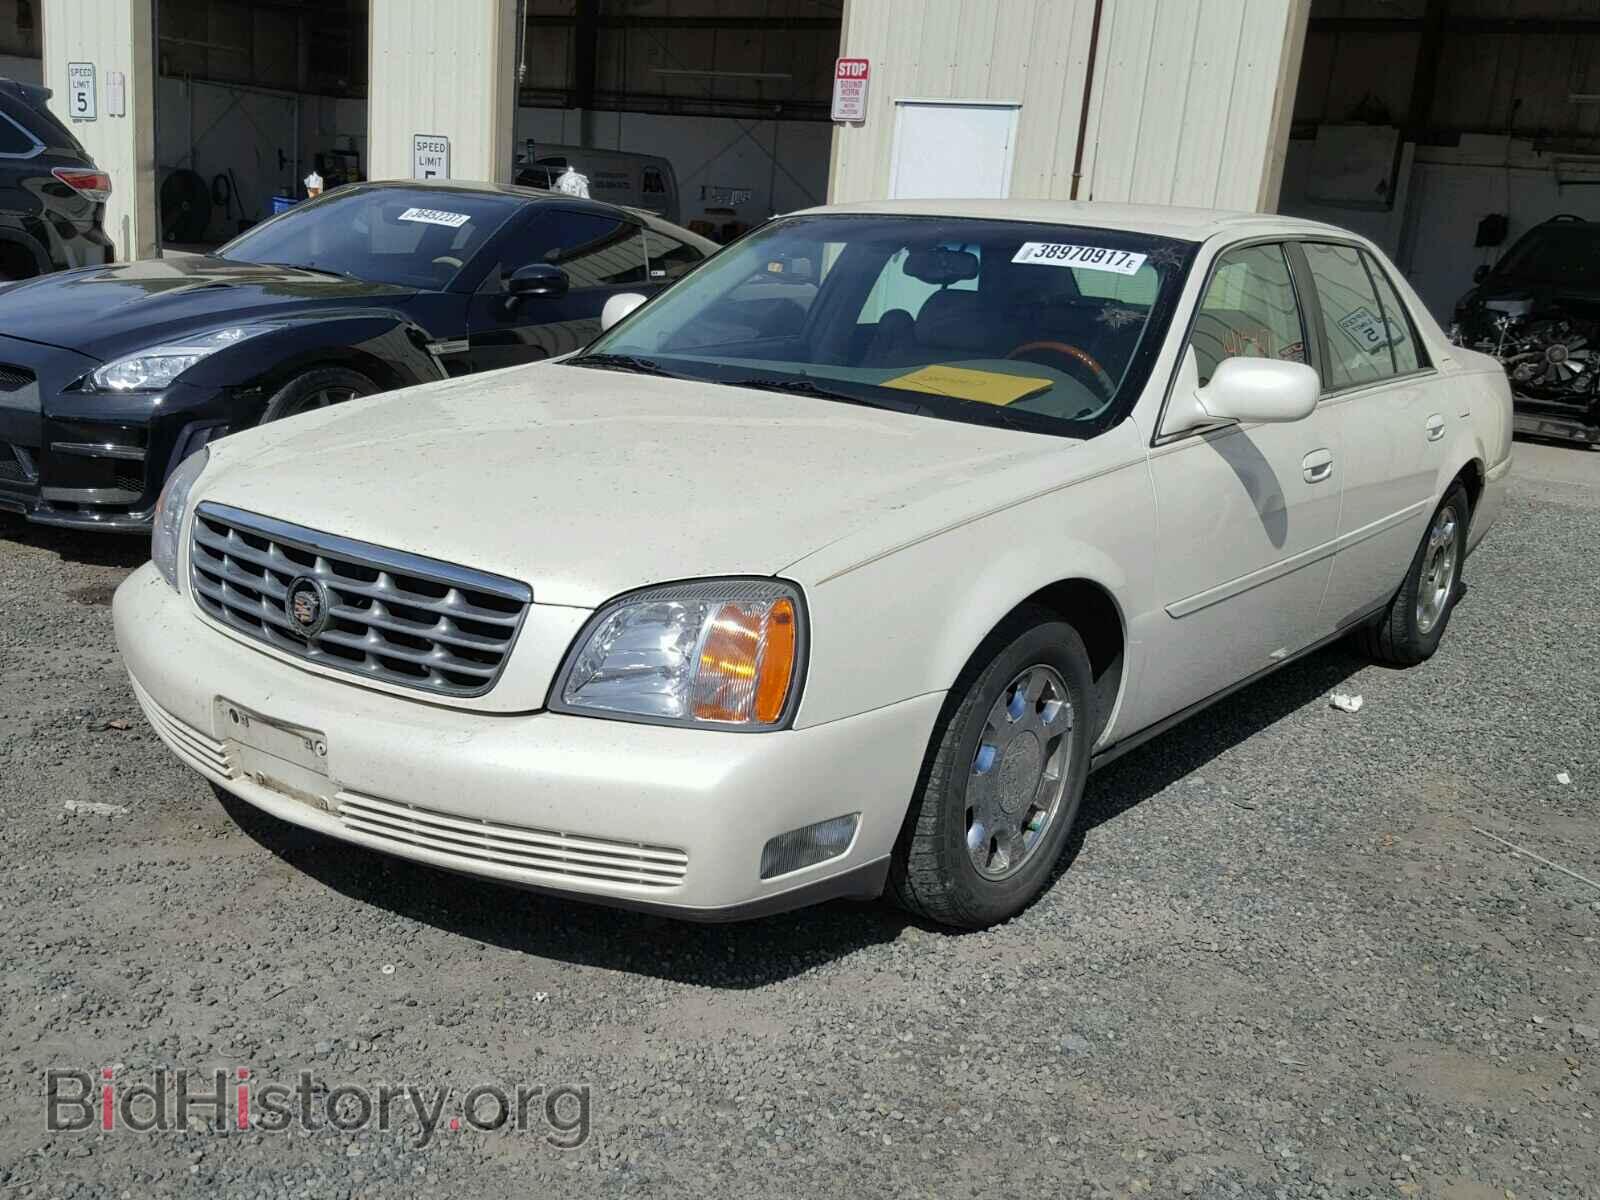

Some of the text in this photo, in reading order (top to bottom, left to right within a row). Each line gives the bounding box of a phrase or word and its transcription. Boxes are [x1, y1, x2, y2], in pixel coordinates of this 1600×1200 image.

[838, 62, 867, 76] STOP
[78, 92, 88, 112] 5
[416, 141, 446, 153] SPEED
[418, 156, 442, 168] LIMIT
